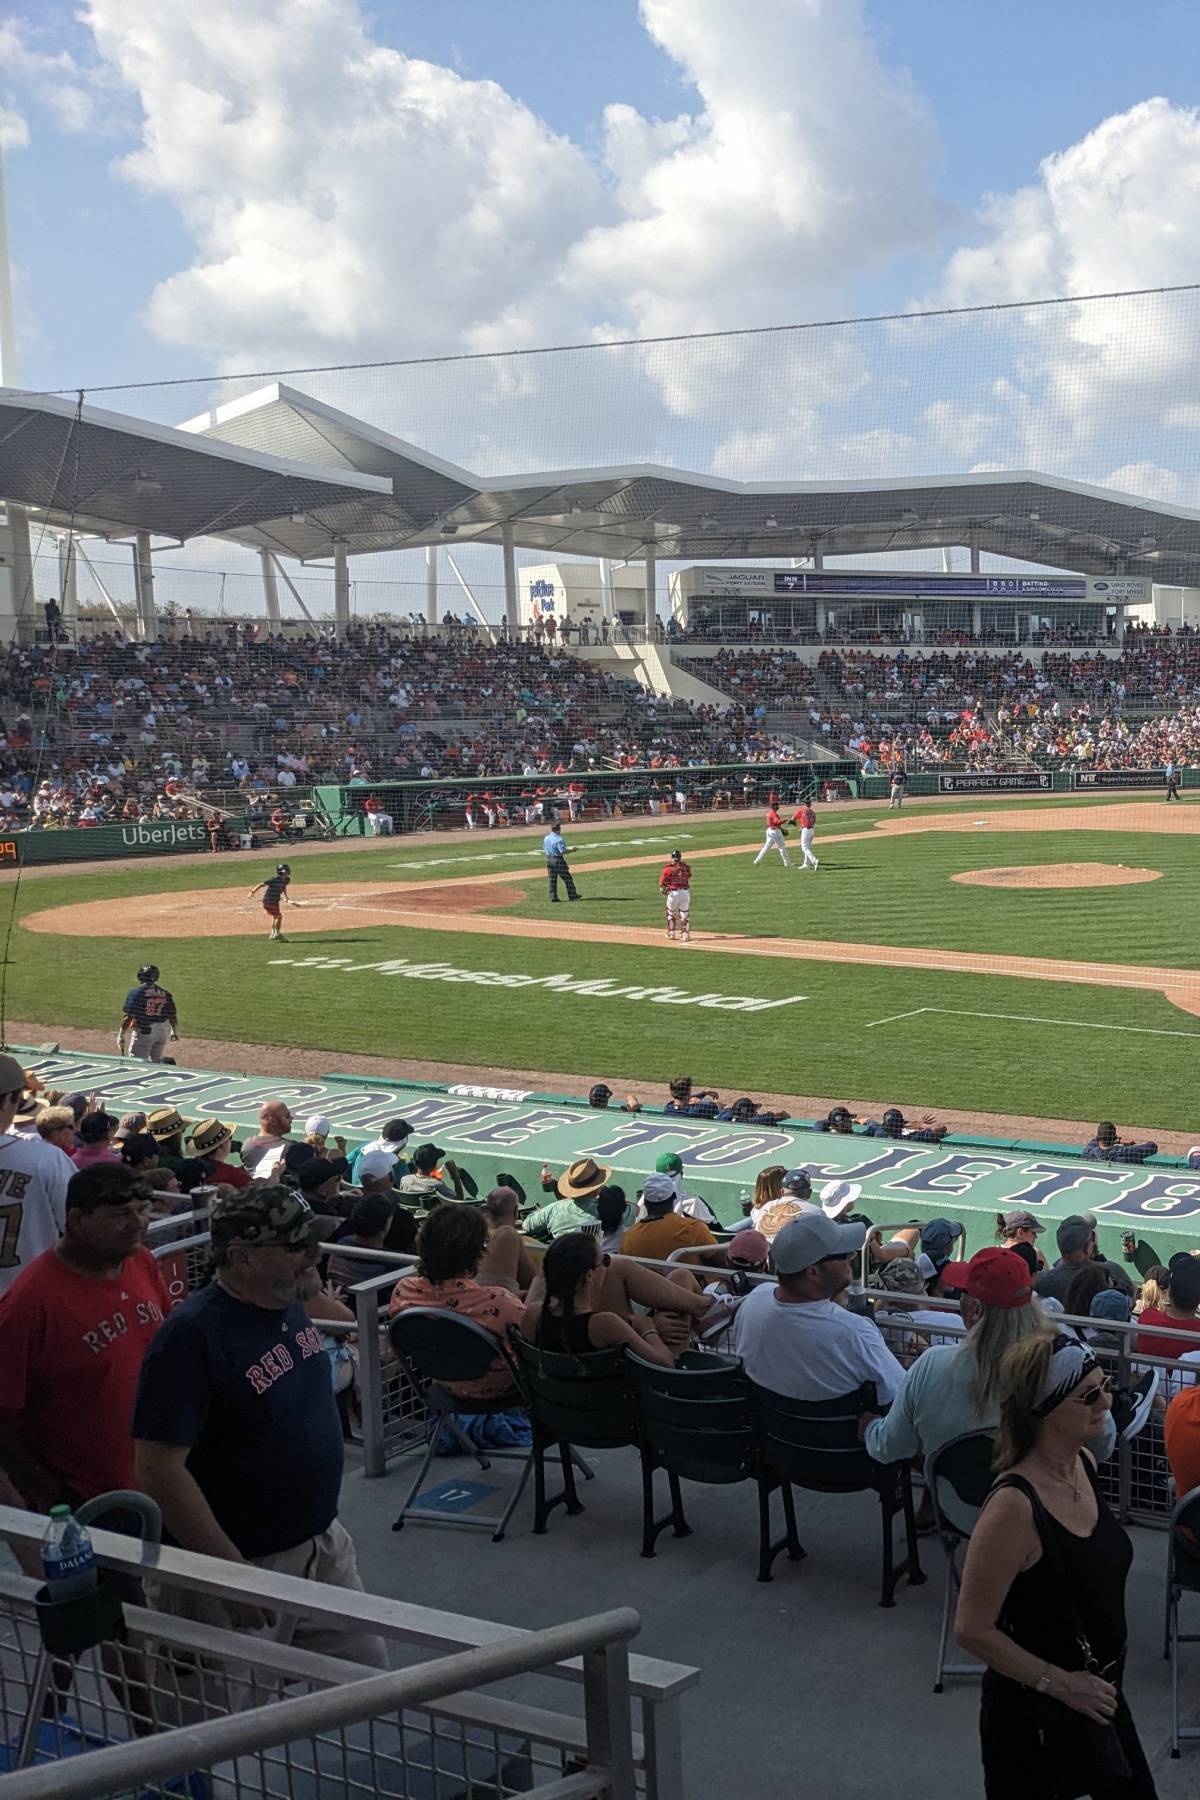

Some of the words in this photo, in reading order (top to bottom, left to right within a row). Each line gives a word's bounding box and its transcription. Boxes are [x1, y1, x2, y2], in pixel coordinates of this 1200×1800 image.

[956, 779, 996, 787] PERFECT
[122, 824, 205, 845] UberJets
[344, 958, 809, 1012] MassMutual
[21, 1057, 601, 1146] WELCOME
[573, 1121, 795, 1168] TO
[82, 1312, 128, 1354] RED
[246, 1343, 294, 1394] RED
[440, 1489, 472, 1501] 17
